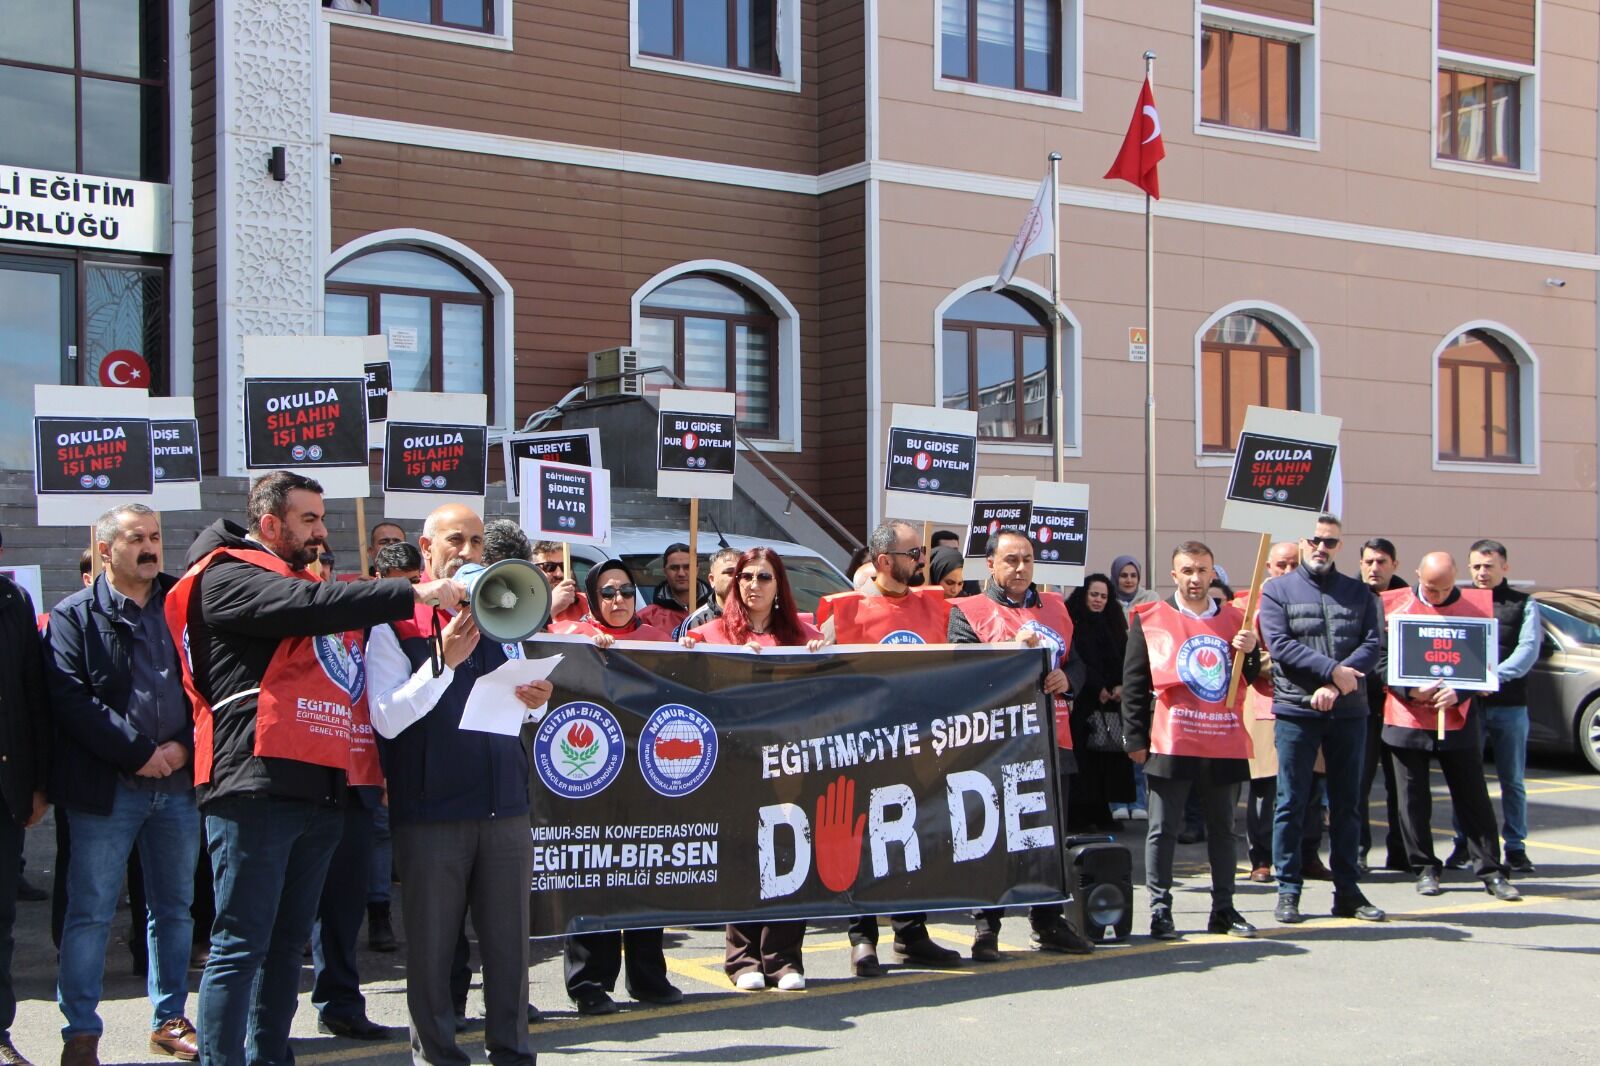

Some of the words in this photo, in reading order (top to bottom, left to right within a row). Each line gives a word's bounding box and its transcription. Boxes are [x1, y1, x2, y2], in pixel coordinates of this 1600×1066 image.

[30, 176, 134, 207] EĞİTİM
[0, 205, 119, 240] ÜRLÜĞÜ
[267, 388, 338, 412] OKULDA
[267, 404, 340, 430] SİLAHIN
[57, 426, 126, 446] OKULDA
[273, 429, 296, 447] İŞİ
[303, 422, 336, 440] NE?
[675, 421, 689, 431] BU
[690, 421, 722, 434] GİDİŞE
[403, 432, 463, 449] OKULDA
[529, 442, 572, 455] NEREYE
[664, 437, 682, 446] DUR
[698, 438, 732, 448] DİYELİM
[906, 438, 922, 450] BU
[923, 440, 960, 455] GİDİŞE
[57, 440, 127, 461] SİLAHIN
[402, 445, 464, 463] SİLAHIN
[1254, 449, 1312, 461] OKULDA
[63, 461, 85, 476] İŞİ
[91, 456, 123, 472] NE?
[407, 463, 426, 477] İŞİ
[431, 460, 459, 473] NE?
[893, 455, 913, 465] DUR
[932, 458, 970, 471] DİYELİM
[1251, 462, 1312, 474] SİLAHIN
[545, 472, 586, 484] EĞİTİMCİYE
[1252, 474, 1272, 488] İŞİ
[1275, 474, 1304, 487] NE?
[548, 482, 585, 496] ŞİDDETE
[547, 498, 586, 513] HAYIR
[983, 509, 995, 519] BU
[973, 525, 988, 534] DUR
[1031, 515, 1044, 524] BU
[1045, 516, 1075, 527] GİDİŞE
[1053, 532, 1083, 541] DİYELİM
[1418, 627, 1467, 639] NEREYE
[1432, 638, 1453, 650] BU
[1424, 651, 1461, 665] GİDİŞ
[539, 706, 620, 744] EĞİTİM-BİR-SEN
[649, 708, 710, 735] MEMUR-SEN
[309, 725, 334, 736] GENEL
[762, 722, 920, 779] EĞİTİMCİYE
[931, 703, 1040, 757] ŞİDDETE
[946, 759, 1055, 863] DE
[531, 826, 600, 841] MEMUR-SEN
[605, 823, 719, 839] KONFEDERASYONU
[533, 841, 718, 872] EĞİTİM-BİR-SEN
[531, 872, 601, 891] EĞİTİMCİLER
[606, 869, 651, 887] BİRLİĞİ
[655, 867, 718, 885] SENDİKASI
